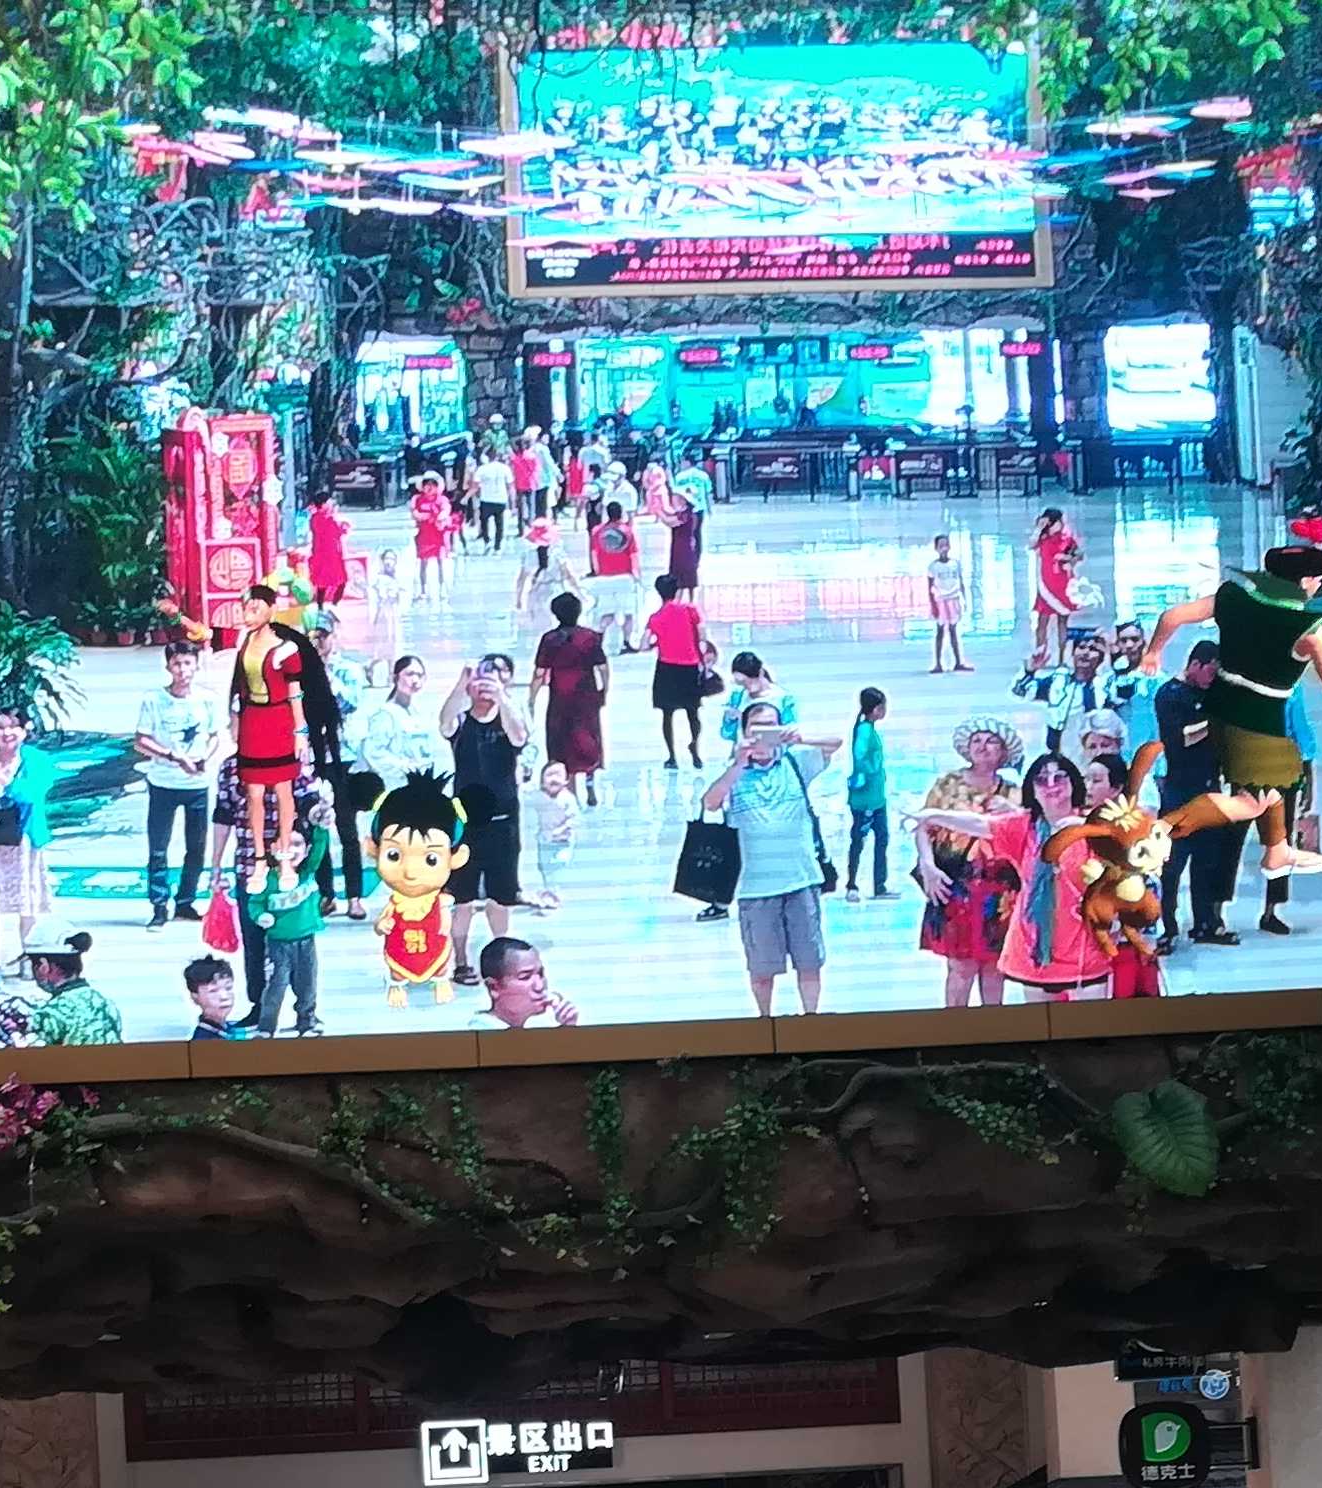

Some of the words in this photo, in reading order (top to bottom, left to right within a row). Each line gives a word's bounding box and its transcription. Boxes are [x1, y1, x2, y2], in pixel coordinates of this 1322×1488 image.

[486, 1420, 614, 1456] 景区出口
[528, 1454, 572, 1473] EXIT
[1141, 1463, 1196, 1481] 德克士
